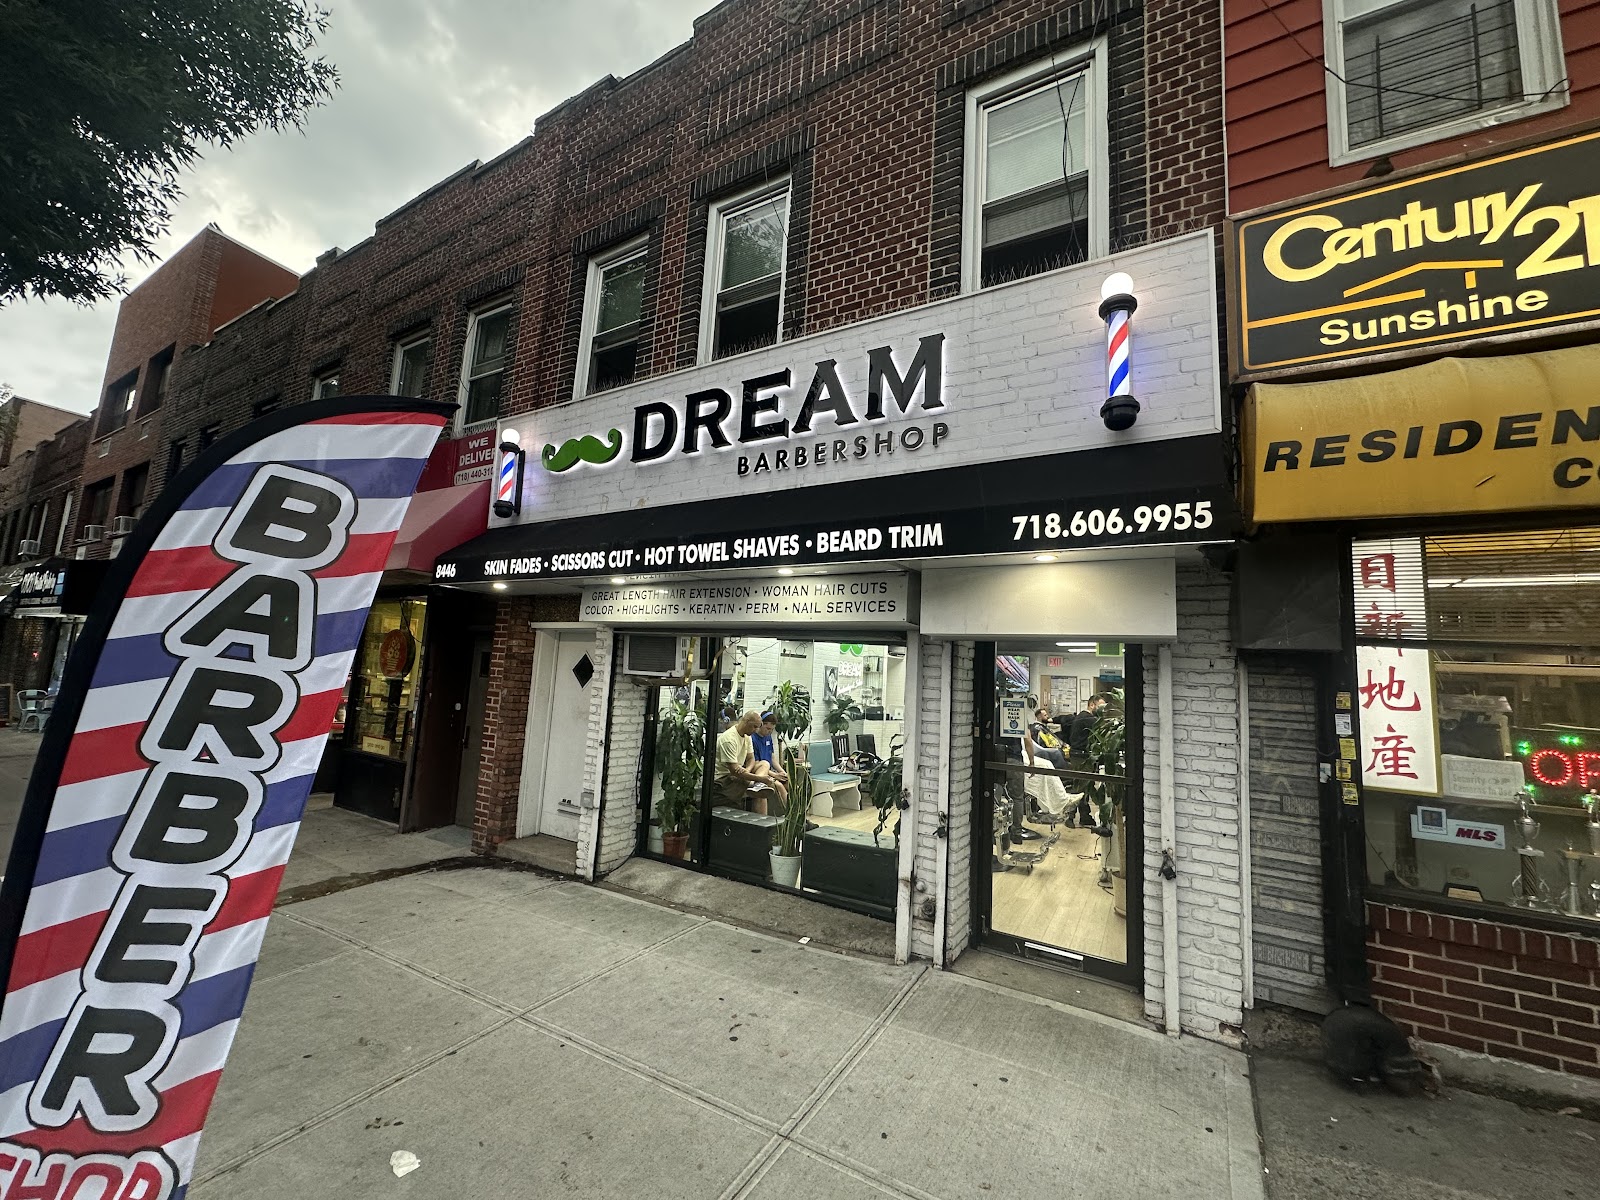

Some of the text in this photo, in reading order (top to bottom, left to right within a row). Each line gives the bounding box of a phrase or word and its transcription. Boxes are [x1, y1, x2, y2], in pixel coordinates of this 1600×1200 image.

[1263, 183, 1543, 282] Century
[1320, 289, 1549, 345] Sunshine
[630, 332, 946, 463] DREAM
[468, 436, 489, 449] WE
[737, 421, 949, 476] BARBERSHOP
[1263, 406, 1600, 473] RESIDEN
[1553, 457, 1600, 488] C
[1012, 500, 1214, 541] 718.606.9955
[484, 522, 943, 576] SKIN FADES SCISSORS CUT HOT TOWEL SHAVES BEARD TRIM
[435, 563, 457, 579] 8446
[584, 600, 896, 615] COLOR HIGHLIGHTS KERATIN PERM NAIL SERVICES
[591, 582, 888, 601] GREAT LENGTH HAIR EXTENSION WOMAN HAIR CUTS
[1048, 657, 1063, 667] EXIT
[40, 473, 344, 1116] BARBER
[1453, 774, 1485, 787] Security
[1456, 827, 1498, 842] MLS
